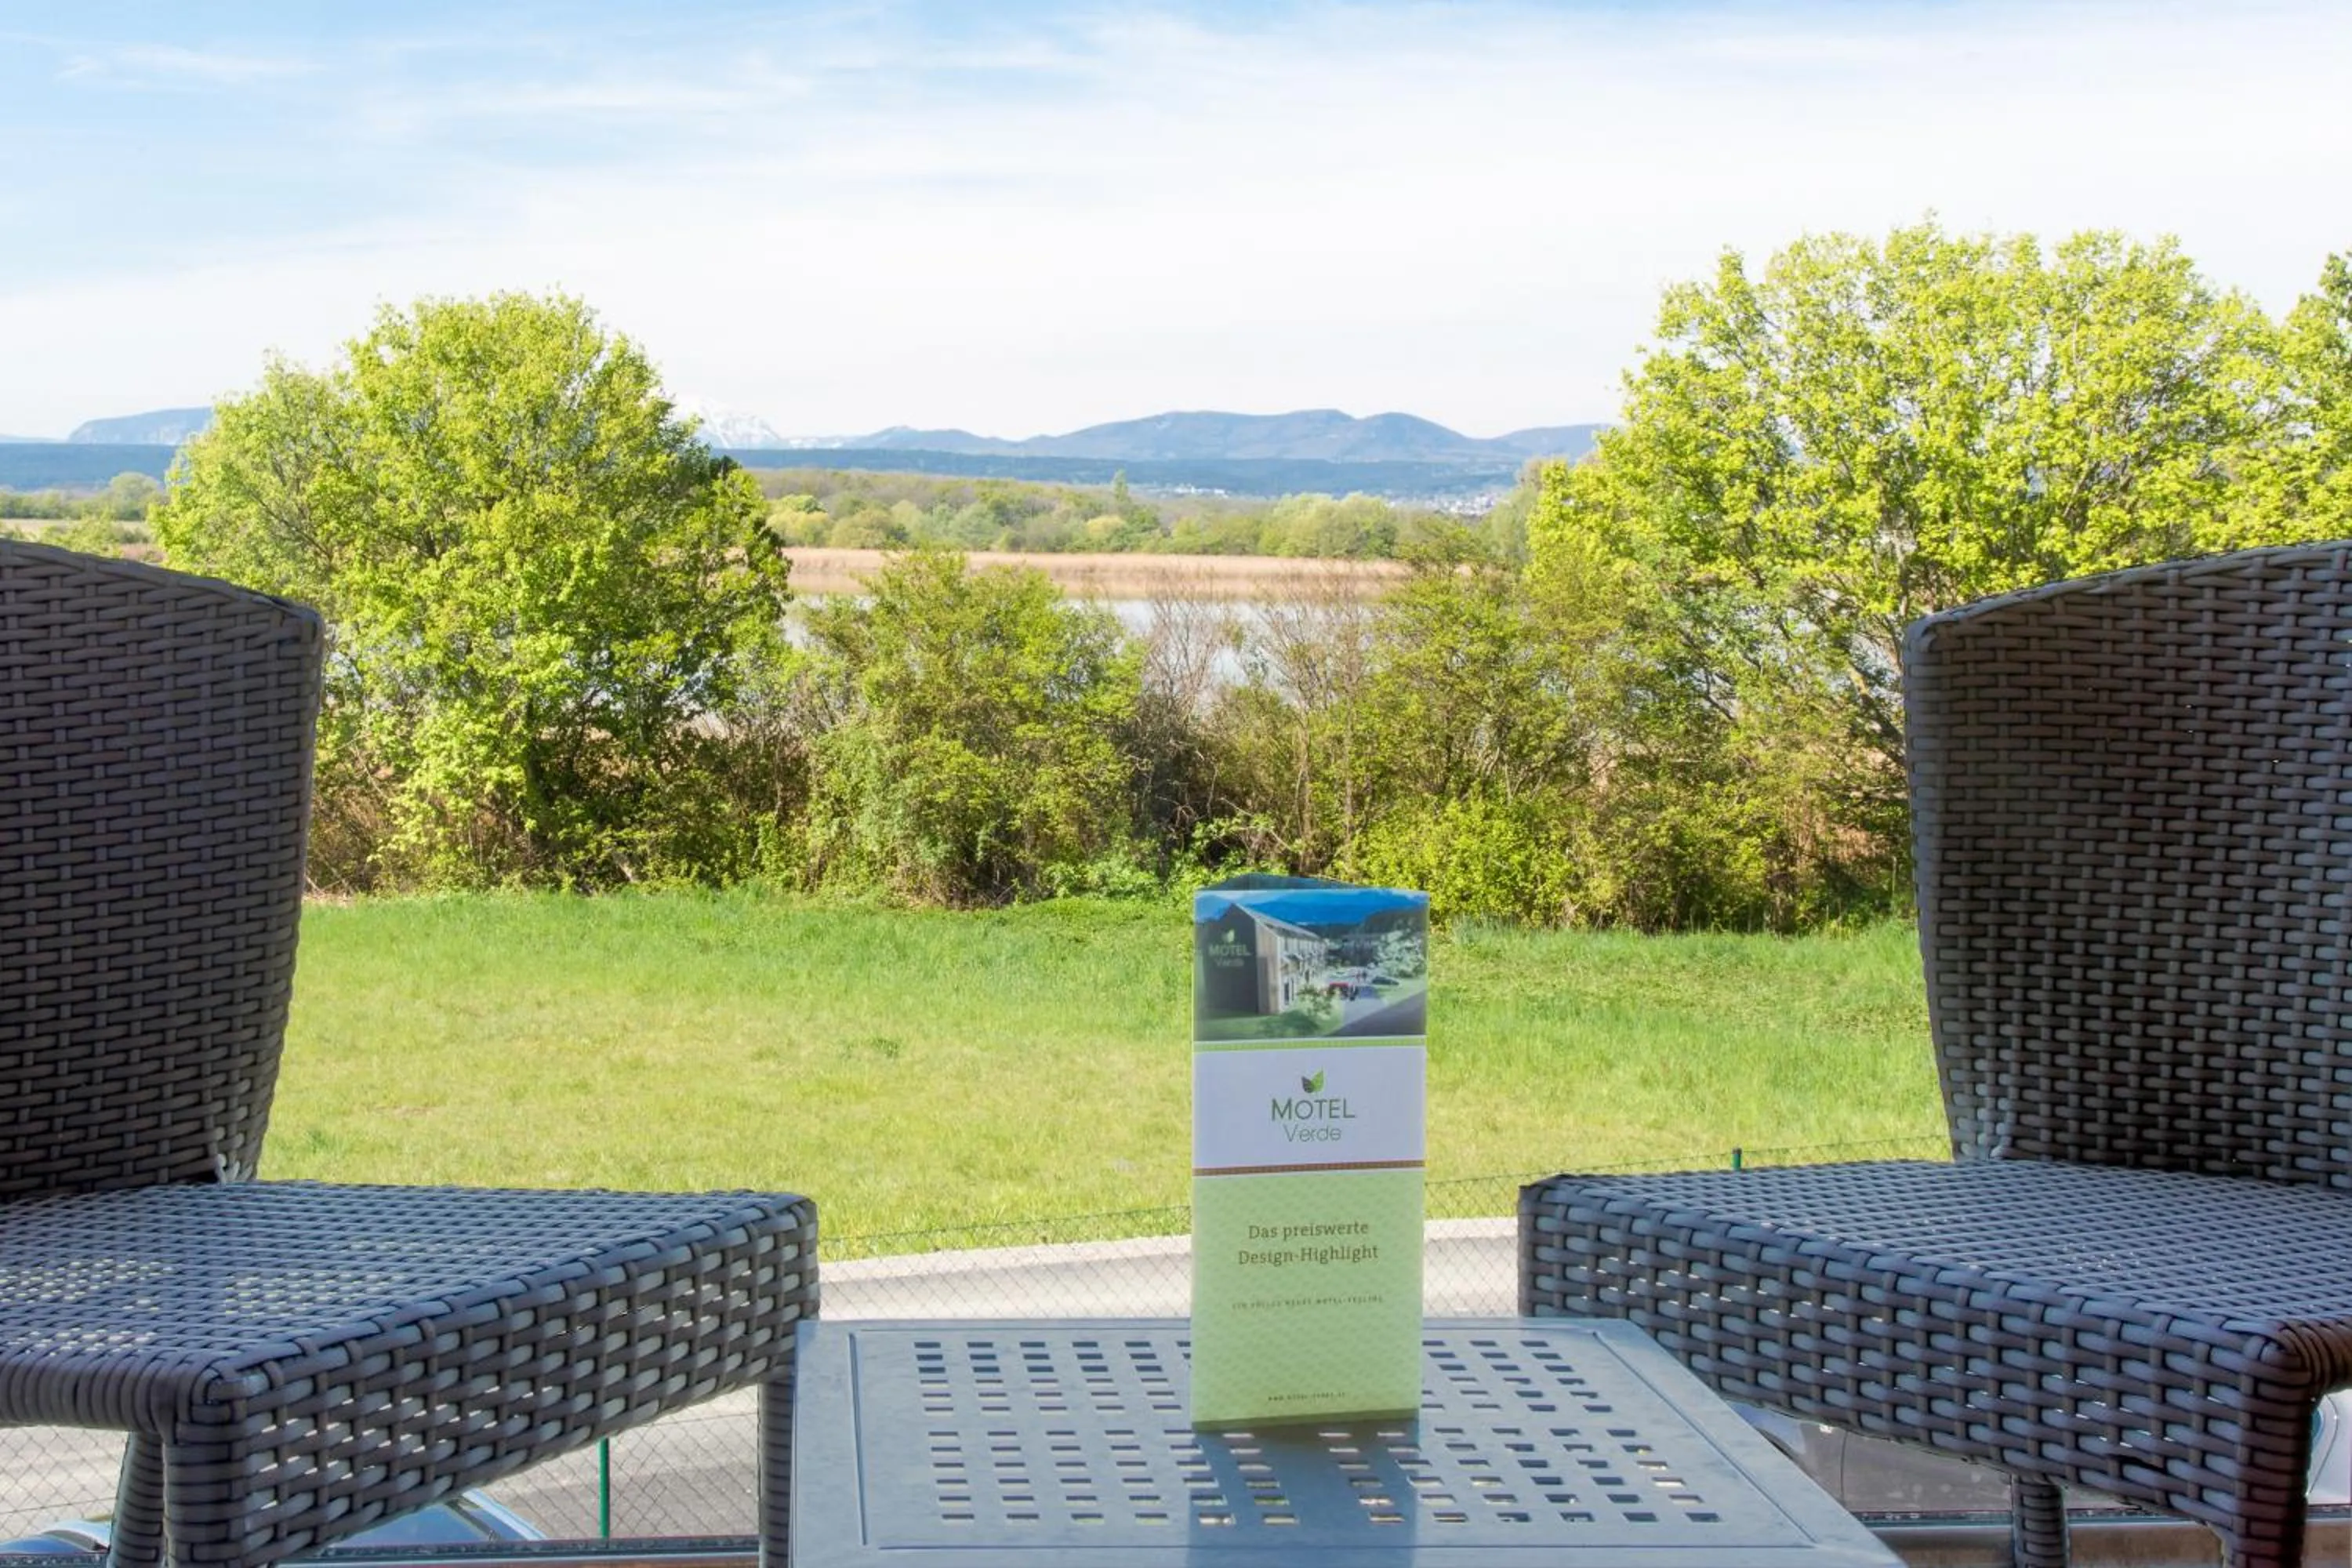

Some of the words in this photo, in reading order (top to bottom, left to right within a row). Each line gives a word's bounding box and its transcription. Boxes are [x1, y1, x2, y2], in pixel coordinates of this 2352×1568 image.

[1208, 943, 1251, 956] MOTEL
[1271, 1098, 1356, 1121] MOTEL
[1283, 1123, 1342, 1142] Verde
[1248, 1225, 1278, 1240] Das
[1283, 1221, 1370, 1241] preiswerte
[1238, 1243, 1379, 1267] Design-Highlight
